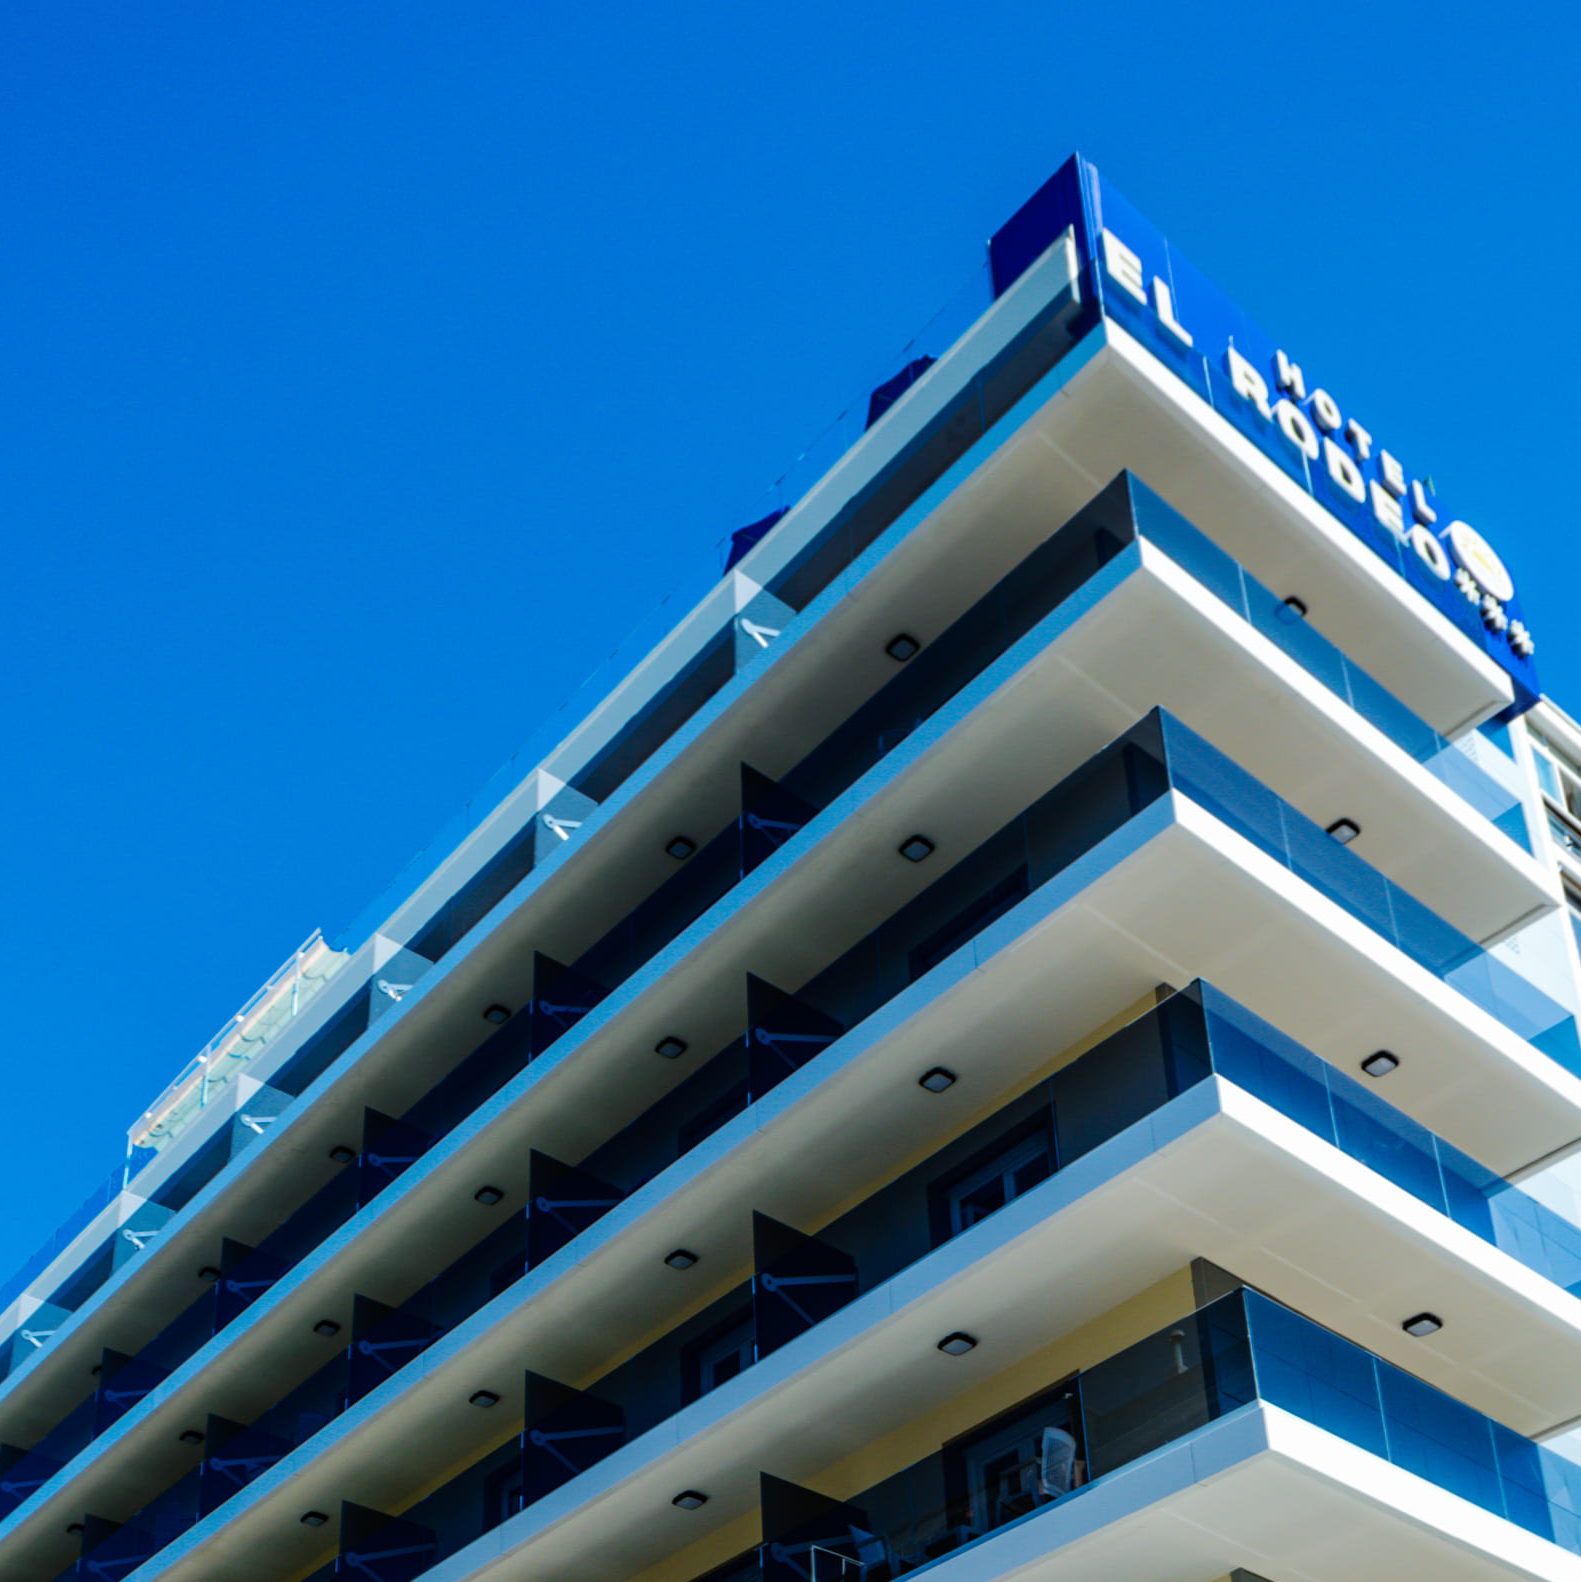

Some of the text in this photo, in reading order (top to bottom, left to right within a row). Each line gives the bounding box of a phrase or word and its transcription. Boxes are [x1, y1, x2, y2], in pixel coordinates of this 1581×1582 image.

[1102, 227, 1451, 581] EL RODEO
[1275, 349, 1437, 523] HOTEL
